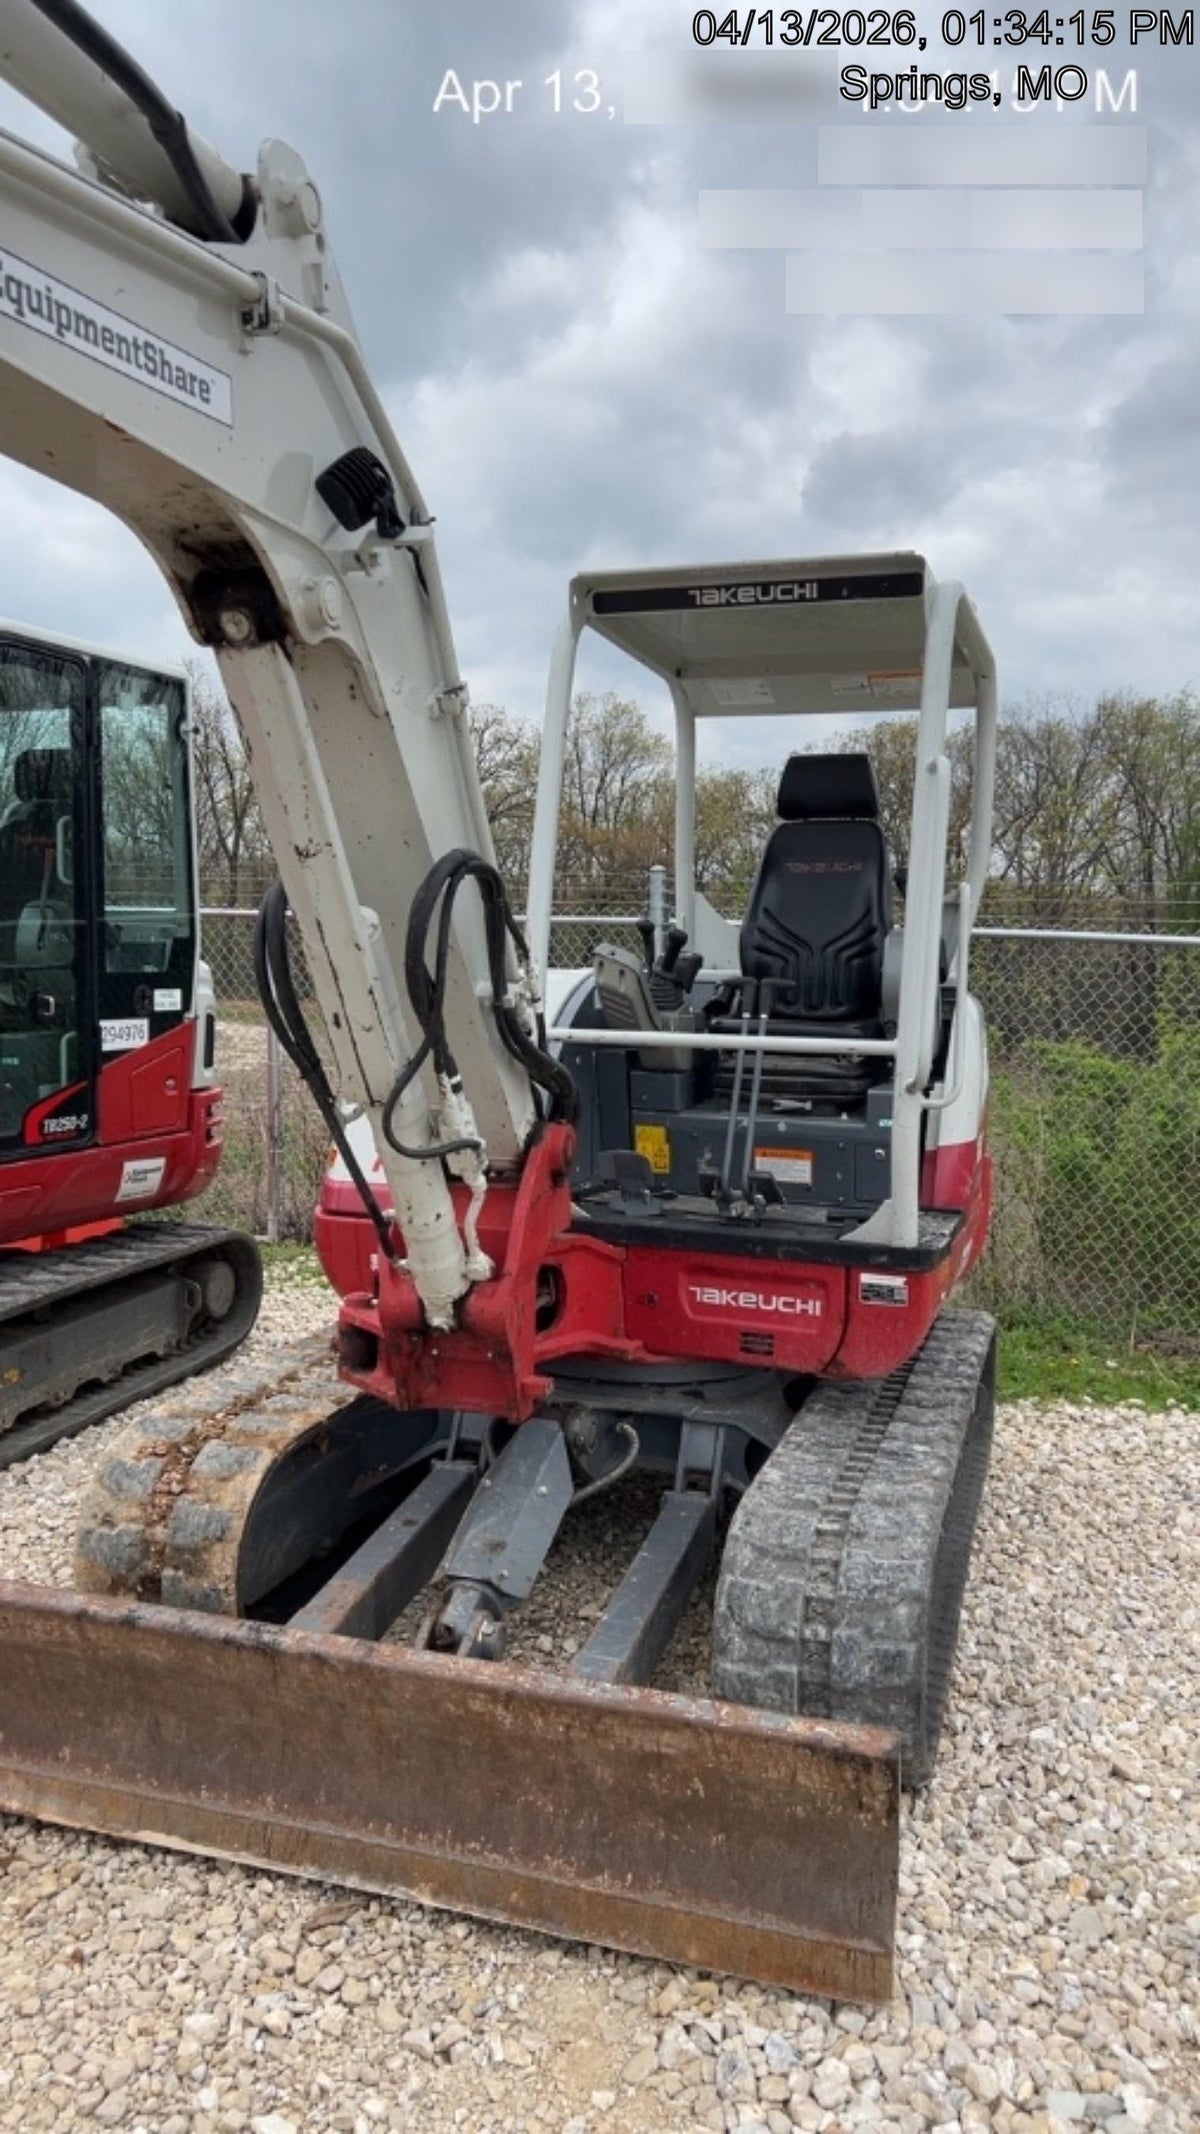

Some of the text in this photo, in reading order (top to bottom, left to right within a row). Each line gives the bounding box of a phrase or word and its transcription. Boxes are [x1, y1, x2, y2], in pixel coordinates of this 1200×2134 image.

[0, 258, 213, 405] quipmentShare
[688, 582, 818, 606] TAKEUCHI
[689, 1286, 821, 1317] TAKEUCHI
